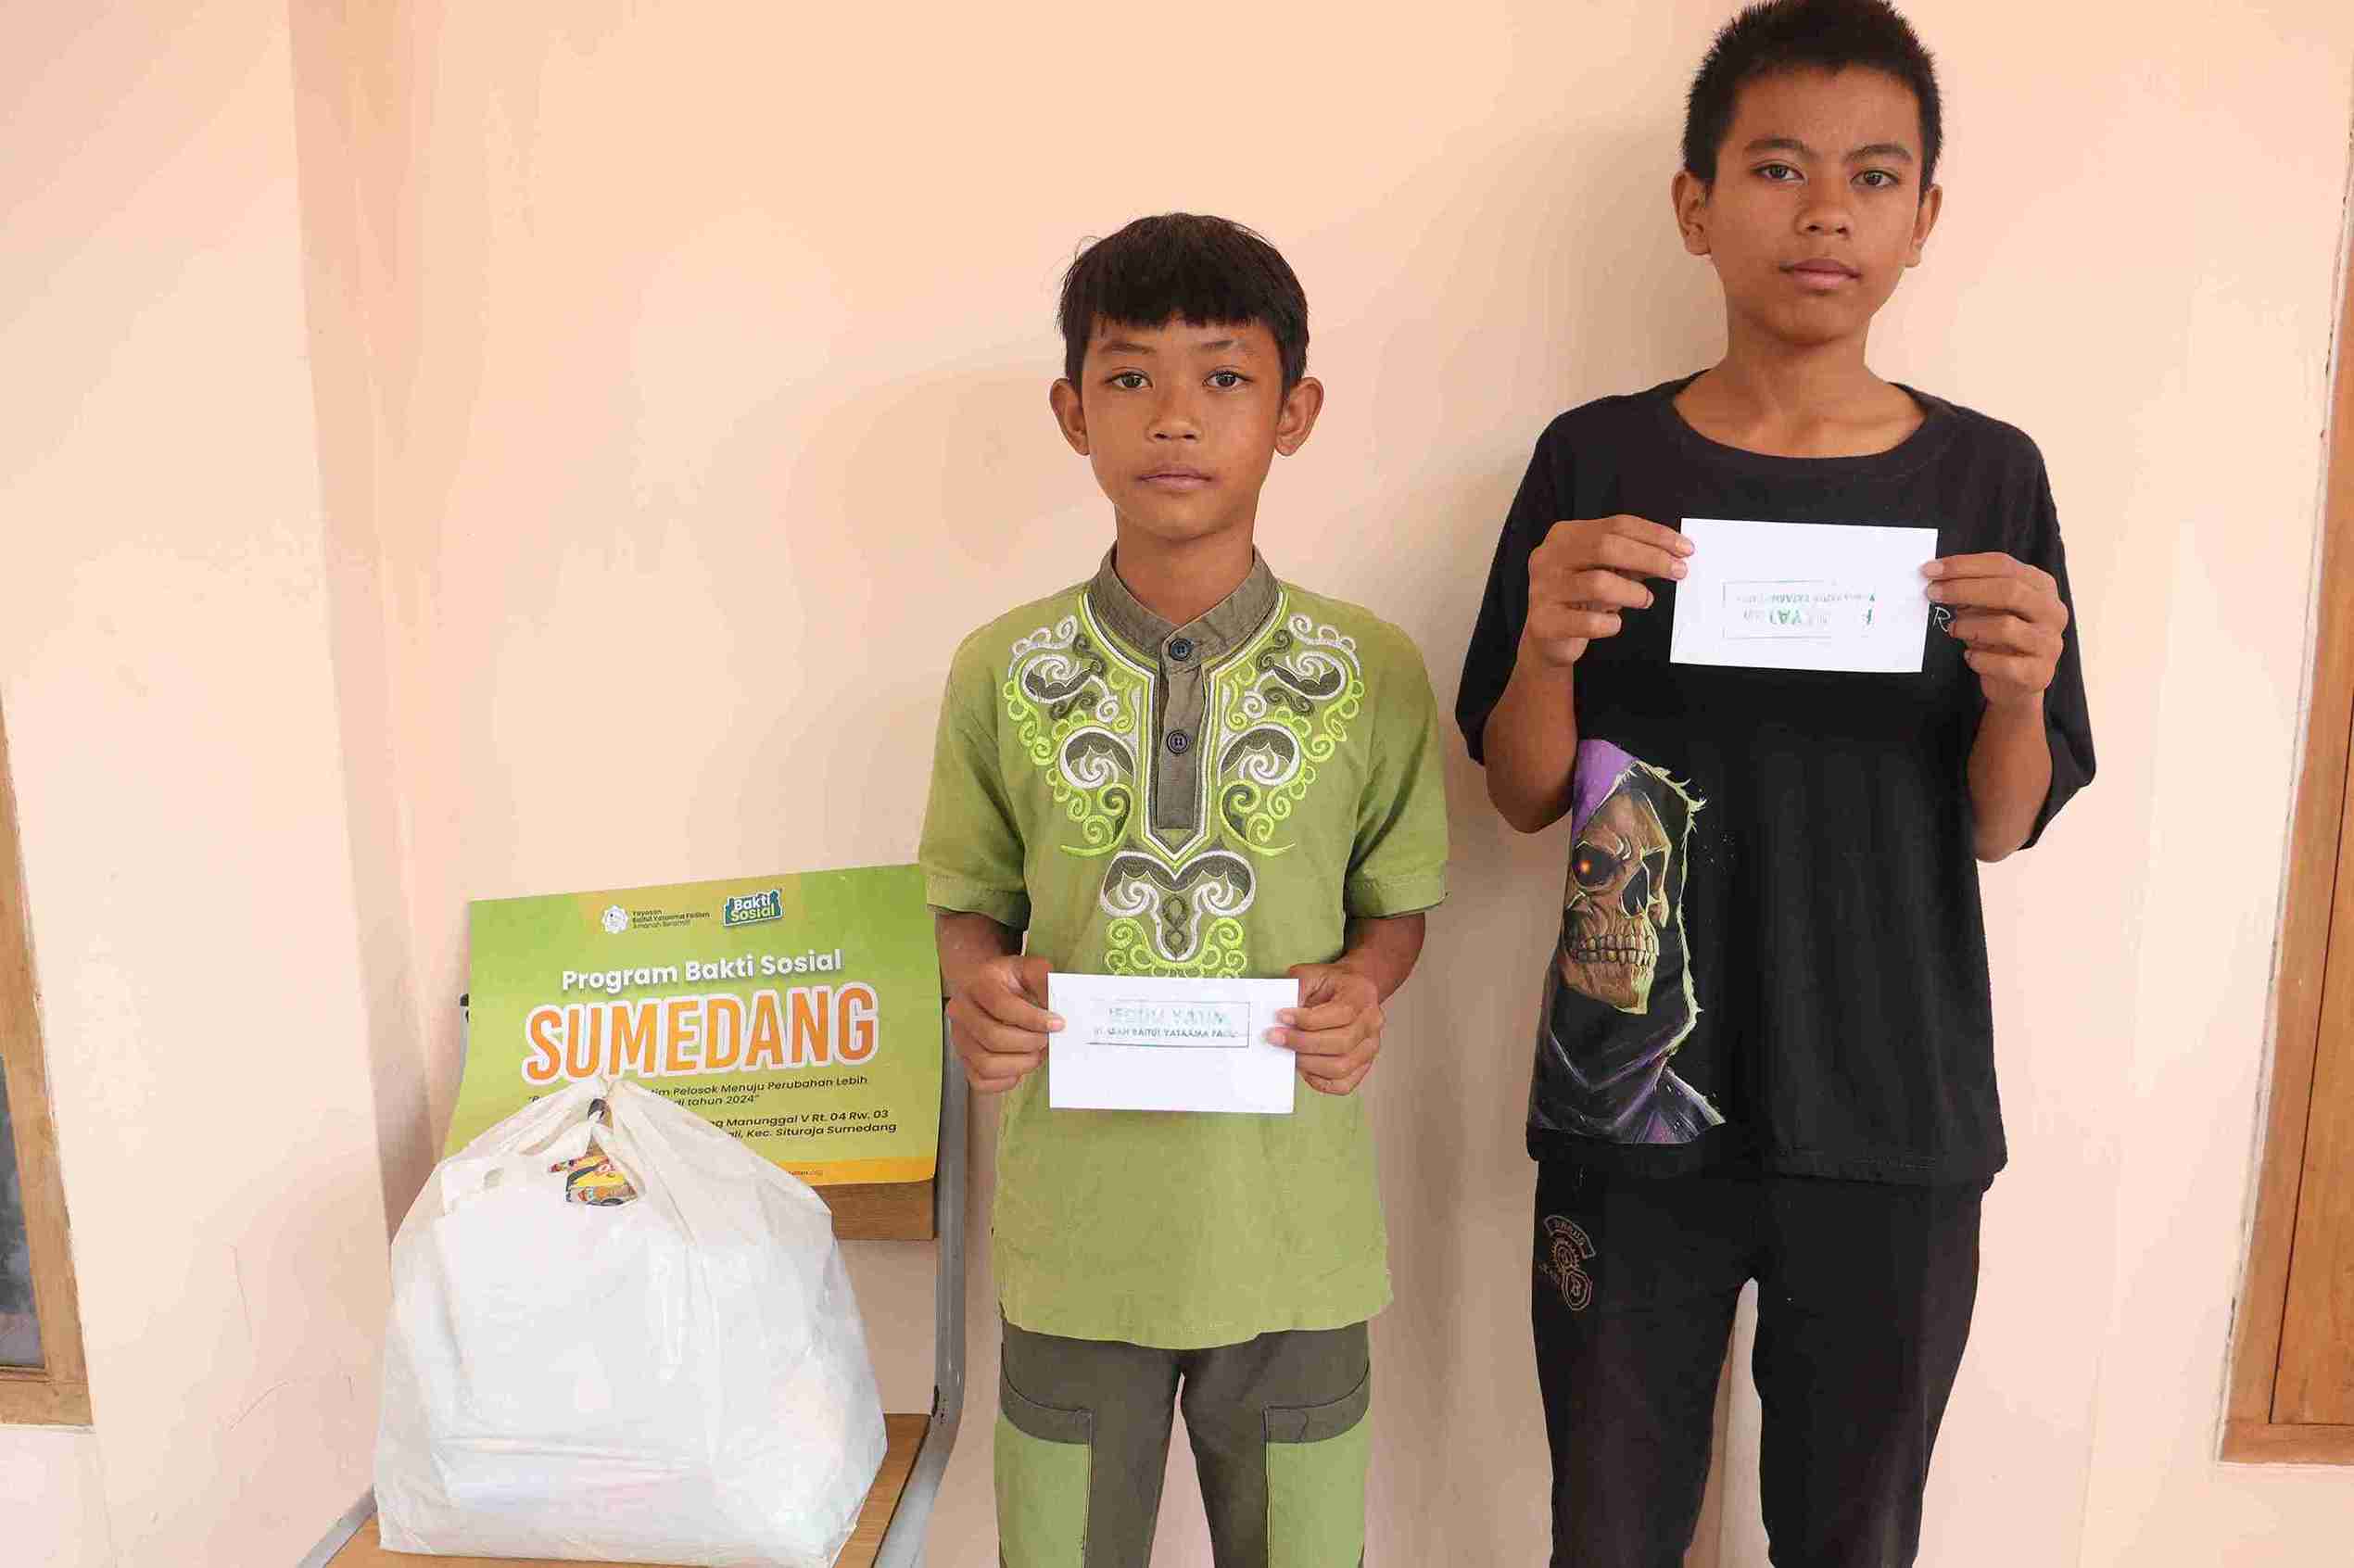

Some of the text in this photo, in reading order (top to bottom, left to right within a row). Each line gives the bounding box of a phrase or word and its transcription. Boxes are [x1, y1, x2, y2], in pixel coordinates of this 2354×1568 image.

[734, 893, 771, 910] Bakti
[730, 903, 776, 922] Sosial
[562, 949, 842, 993] Program Bakti Sosial
[523, 983, 878, 1082] SUMEDANG
[674, 1084, 719, 1095] Pelosok
[721, 1081, 765, 1095] Menuju
[767, 1078, 833, 1092] Perubahan
[836, 1075, 867, 1086] Lebih
[688, 1097, 723, 1106] tahun
[726, 1116, 798, 1128] Manunggal
[801, 1114, 810, 1123] V
[830, 1112, 846, 1121] 04
[849, 1111, 870, 1120] Rw.
[873, 1109, 889, 1119] 03
[747, 1129, 772, 1138] Kec.
[776, 1126, 824, 1137] Situraja
[827, 1123, 897, 1133] Sumedang
